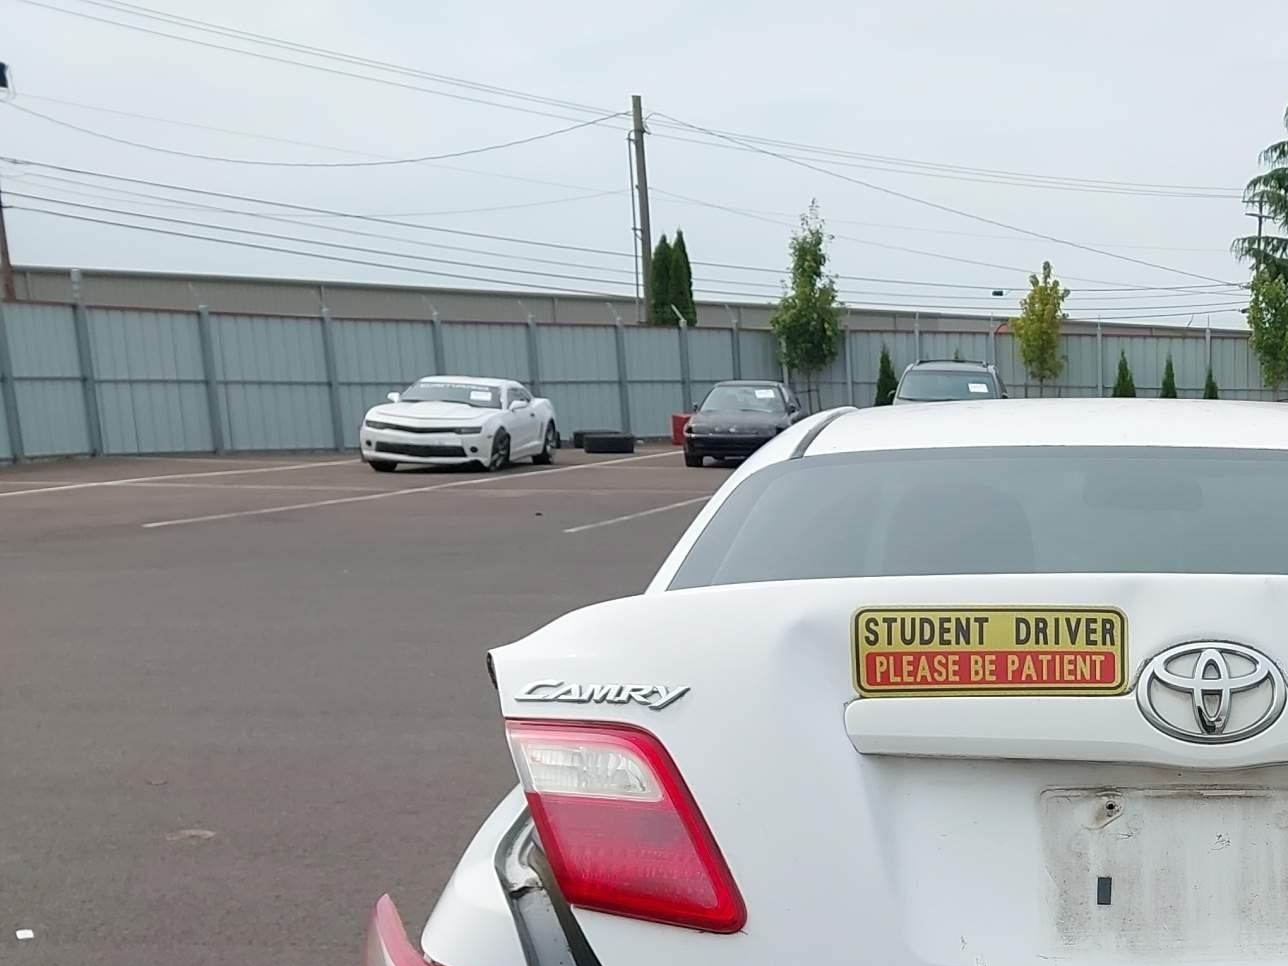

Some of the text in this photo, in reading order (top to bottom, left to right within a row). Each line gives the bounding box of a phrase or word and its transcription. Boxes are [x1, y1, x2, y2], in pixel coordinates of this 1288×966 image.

[864, 616, 1116, 647] STUDENT DRIVER
[875, 654, 1105, 683] PLEASE BE PATIENT
[514, 679, 691, 711] CAMRY
